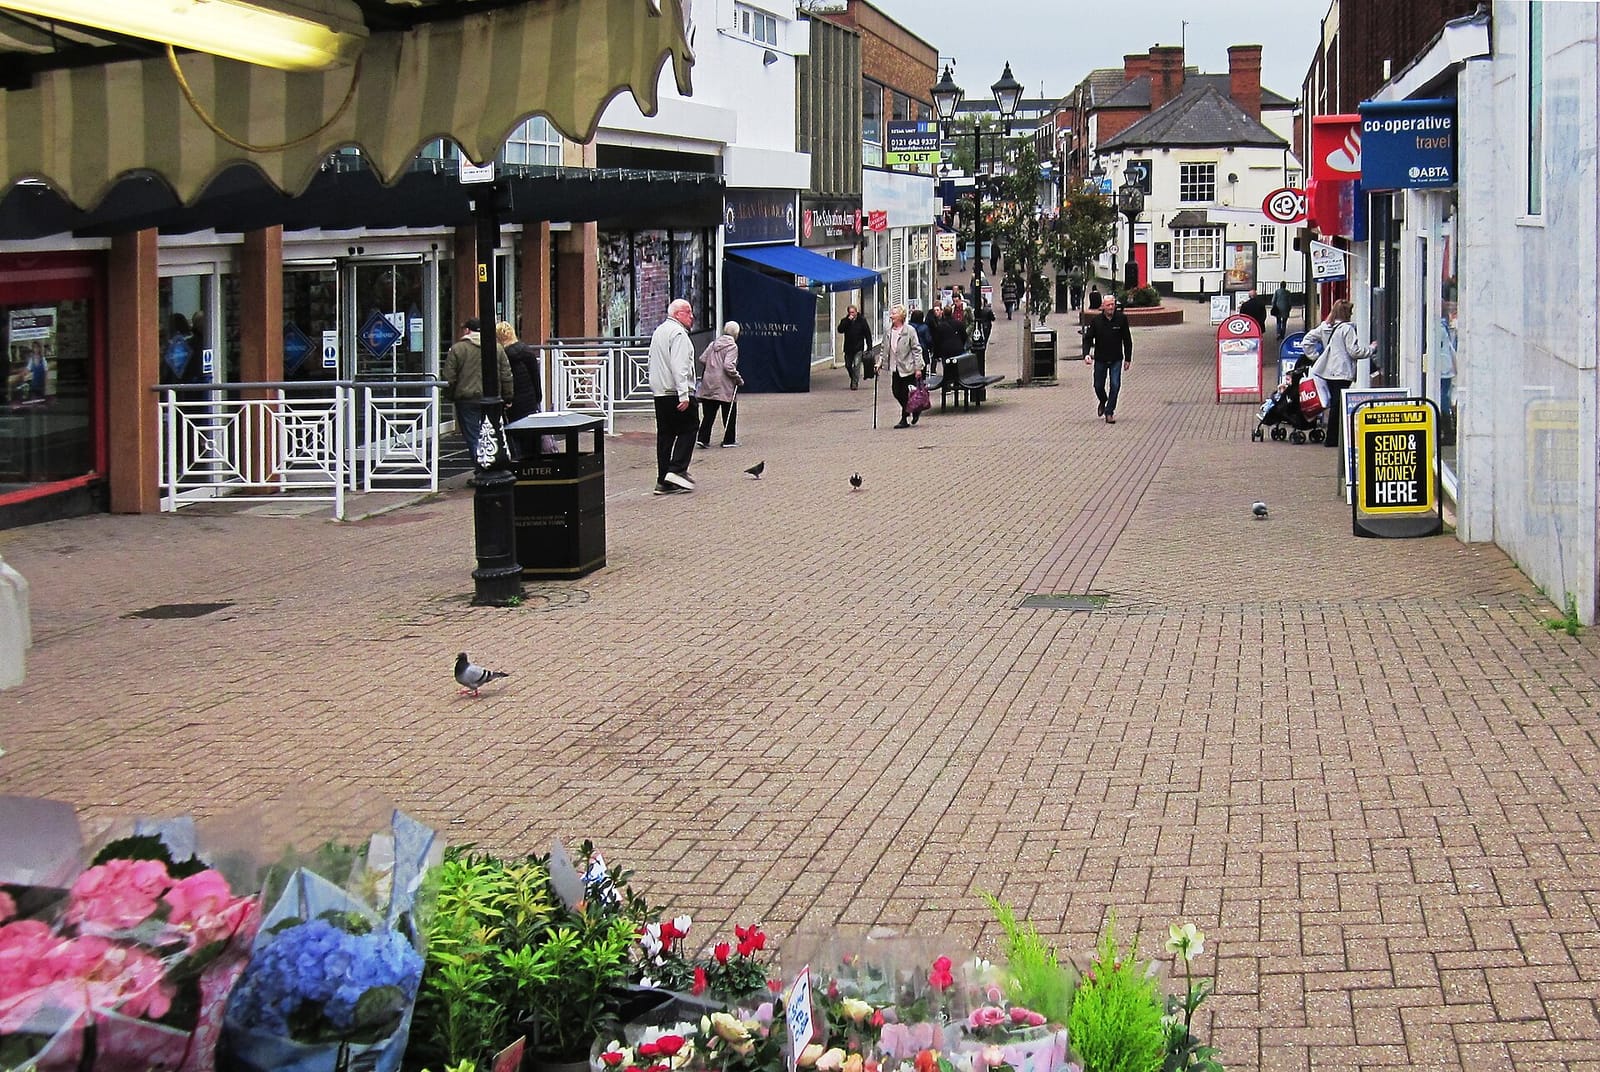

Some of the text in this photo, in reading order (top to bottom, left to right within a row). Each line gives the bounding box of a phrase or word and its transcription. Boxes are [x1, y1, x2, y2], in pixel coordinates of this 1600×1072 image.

[891, 138, 907, 146] 0121
[1415, 134, 1450, 149] travel
[897, 153, 930, 162] TO LET
[1420, 166, 1449, 177] ABTA
[812, 210, 824, 227] The
[479, 266, 486, 276] 8
[754, 321, 798, 332] WARWICK
[1375, 434, 1416, 451] SEND &
[1375, 451, 1416, 466] RECEIVE
[522, 467, 552, 476] LITTER
[1375, 465, 1416, 481] MONEY
[1375, 481, 1417, 503] HERE
